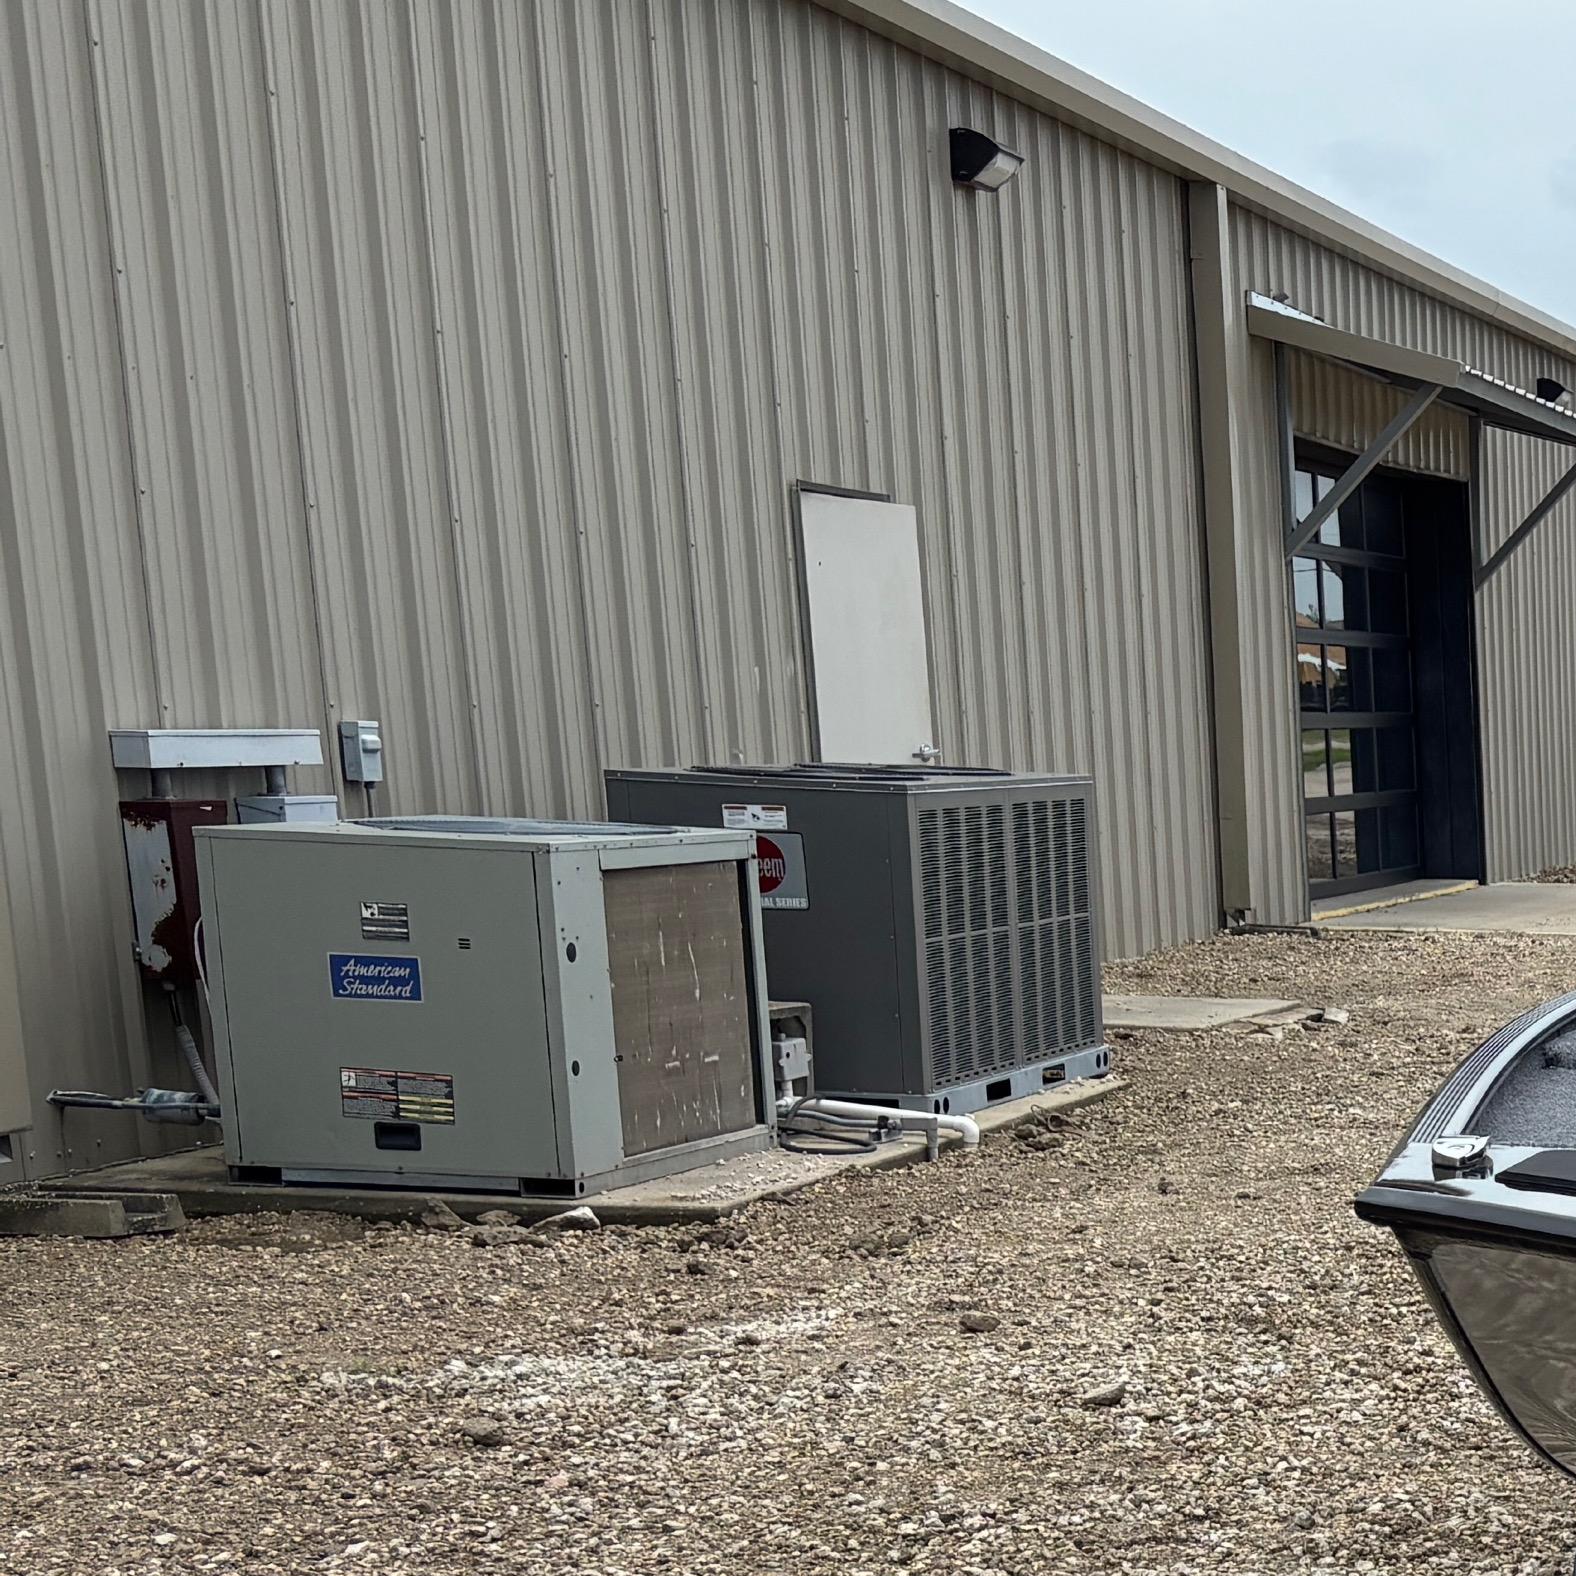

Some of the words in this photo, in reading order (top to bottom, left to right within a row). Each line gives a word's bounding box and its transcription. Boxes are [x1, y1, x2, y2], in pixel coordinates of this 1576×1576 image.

[758, 858, 785, 878] eem
[776, 897, 807, 908] SERIES
[340, 957, 410, 979] American
[339, 978, 414, 998] Standard
